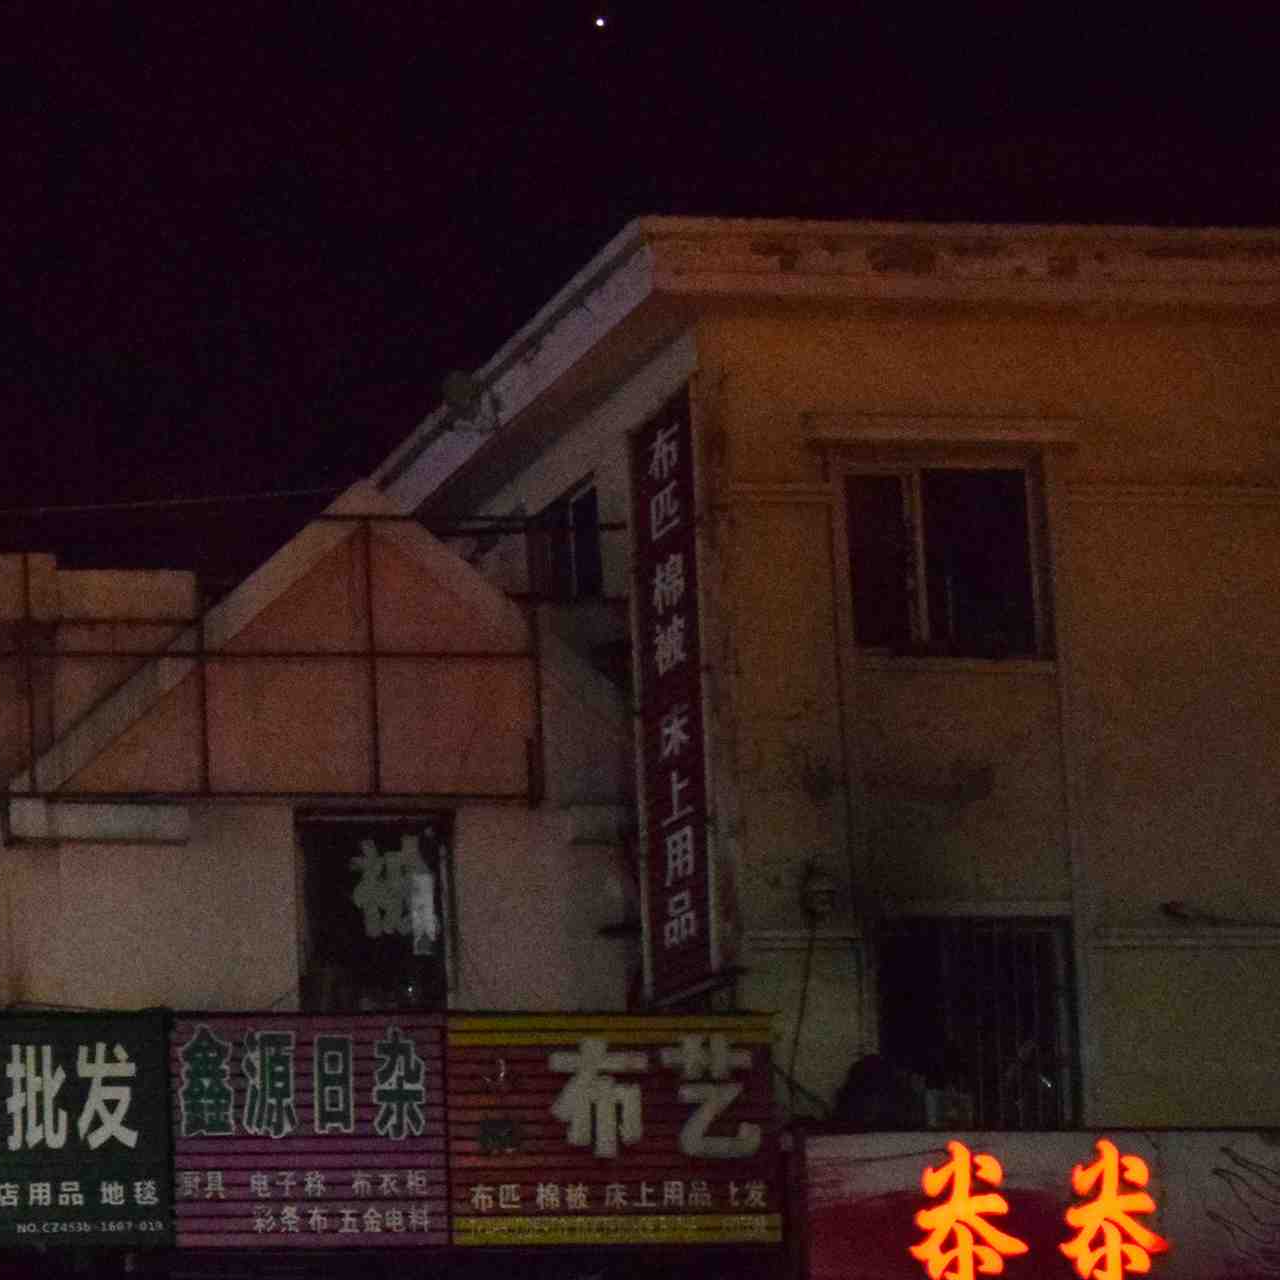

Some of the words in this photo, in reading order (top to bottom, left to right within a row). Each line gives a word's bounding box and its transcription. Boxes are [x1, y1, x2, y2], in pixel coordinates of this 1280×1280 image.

[647, 423, 683, 543] 布匹
[657, 704, 698, 952] 床上用品
[547, 1034, 762, 1158] 布艺
[99, 1180, 160, 1206] 地毯
[180, 1170, 225, 1200] 厨具
[351, 1169, 428, 1198] 布衣柜
[469, 1183, 522, 1211] 布匹
[604, 1180, 713, 1210] 床上用品
